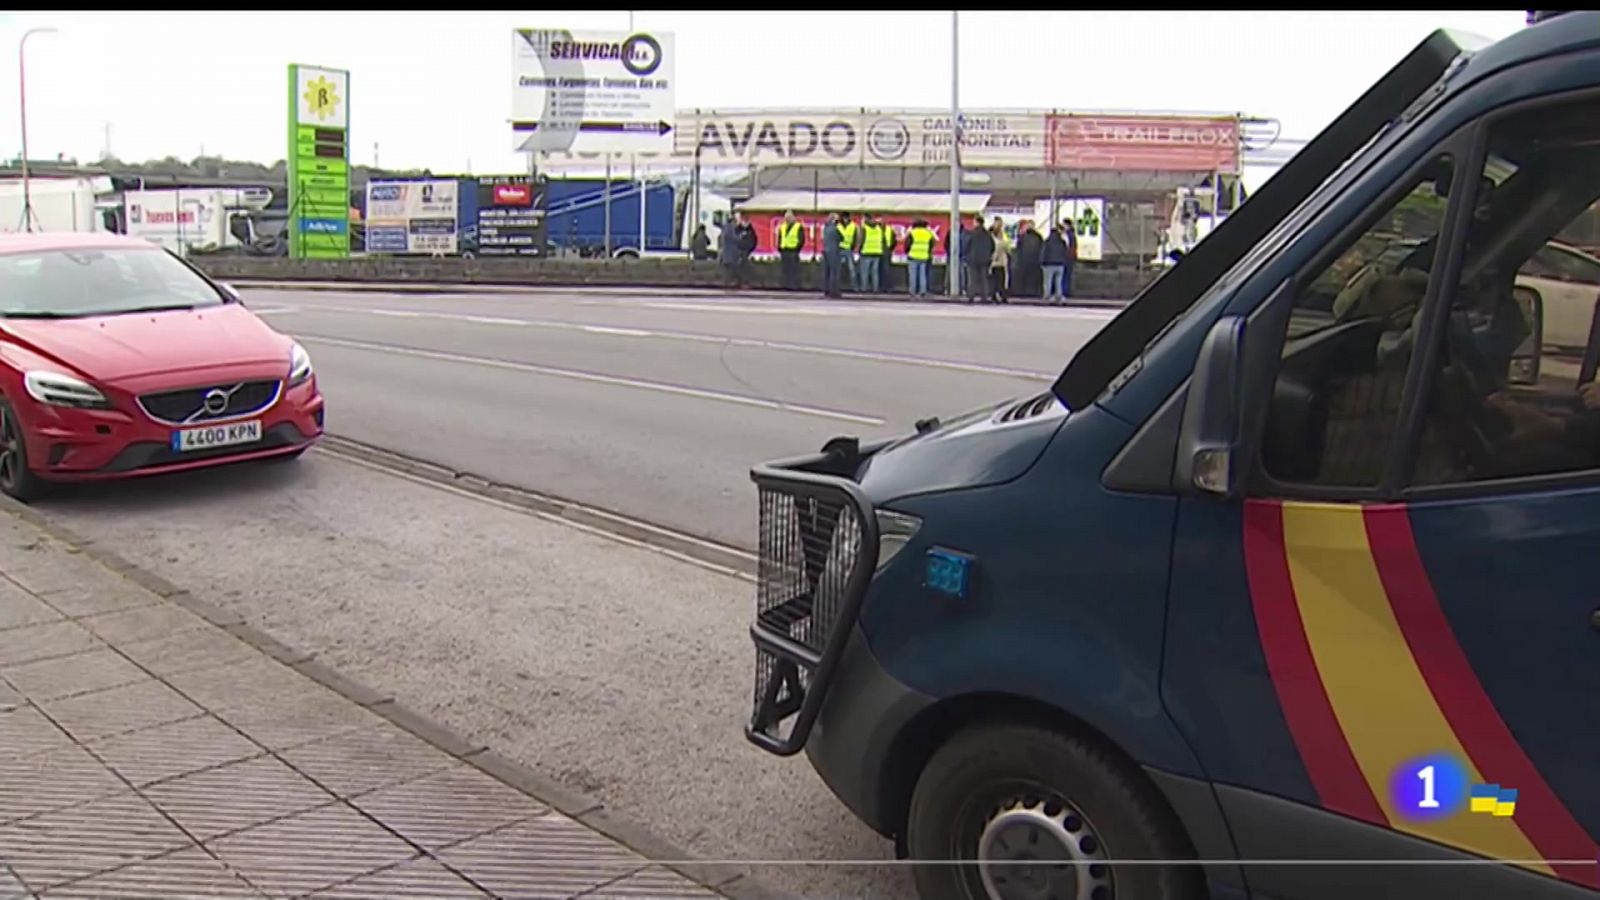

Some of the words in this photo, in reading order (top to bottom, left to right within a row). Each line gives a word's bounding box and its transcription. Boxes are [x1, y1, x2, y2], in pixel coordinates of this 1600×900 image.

[922, 118, 1007, 130] CAMONES
[185, 428, 226, 446] 4400
[228, 422, 257, 440] KPN
